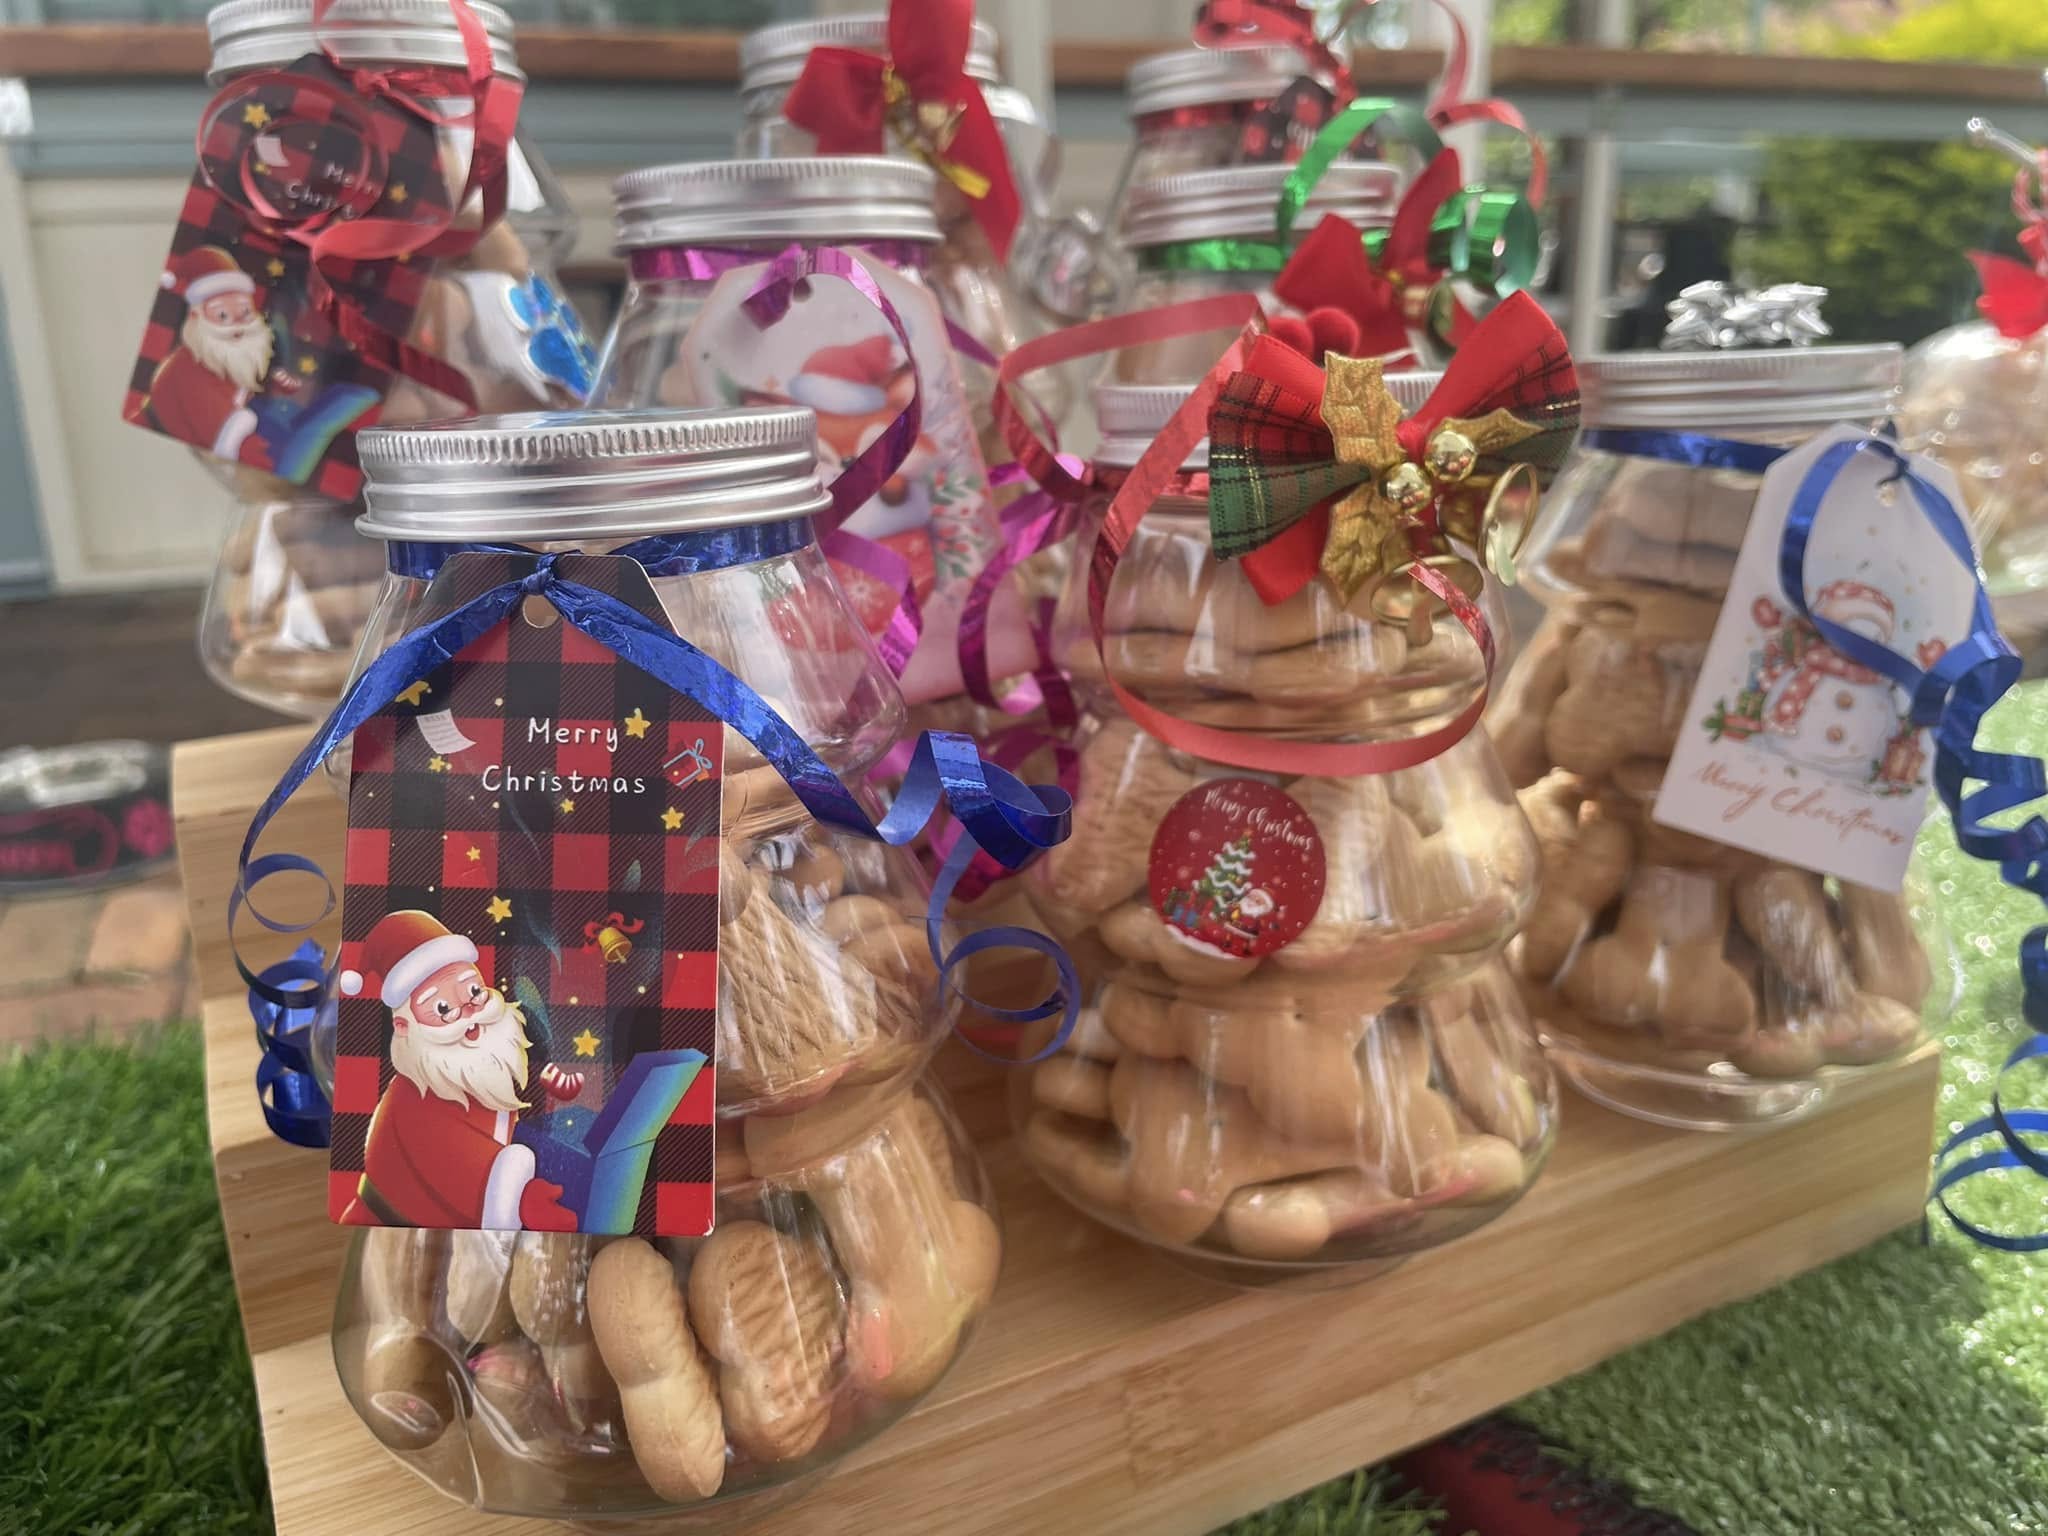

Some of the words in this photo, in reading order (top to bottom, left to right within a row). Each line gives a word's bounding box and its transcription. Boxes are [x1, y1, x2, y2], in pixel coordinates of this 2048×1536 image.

[527, 716, 619, 753] Merry
[482, 764, 647, 793] Christmas
[1695, 760, 1766, 823] Merry
[1768, 786, 1905, 846] Christmas
